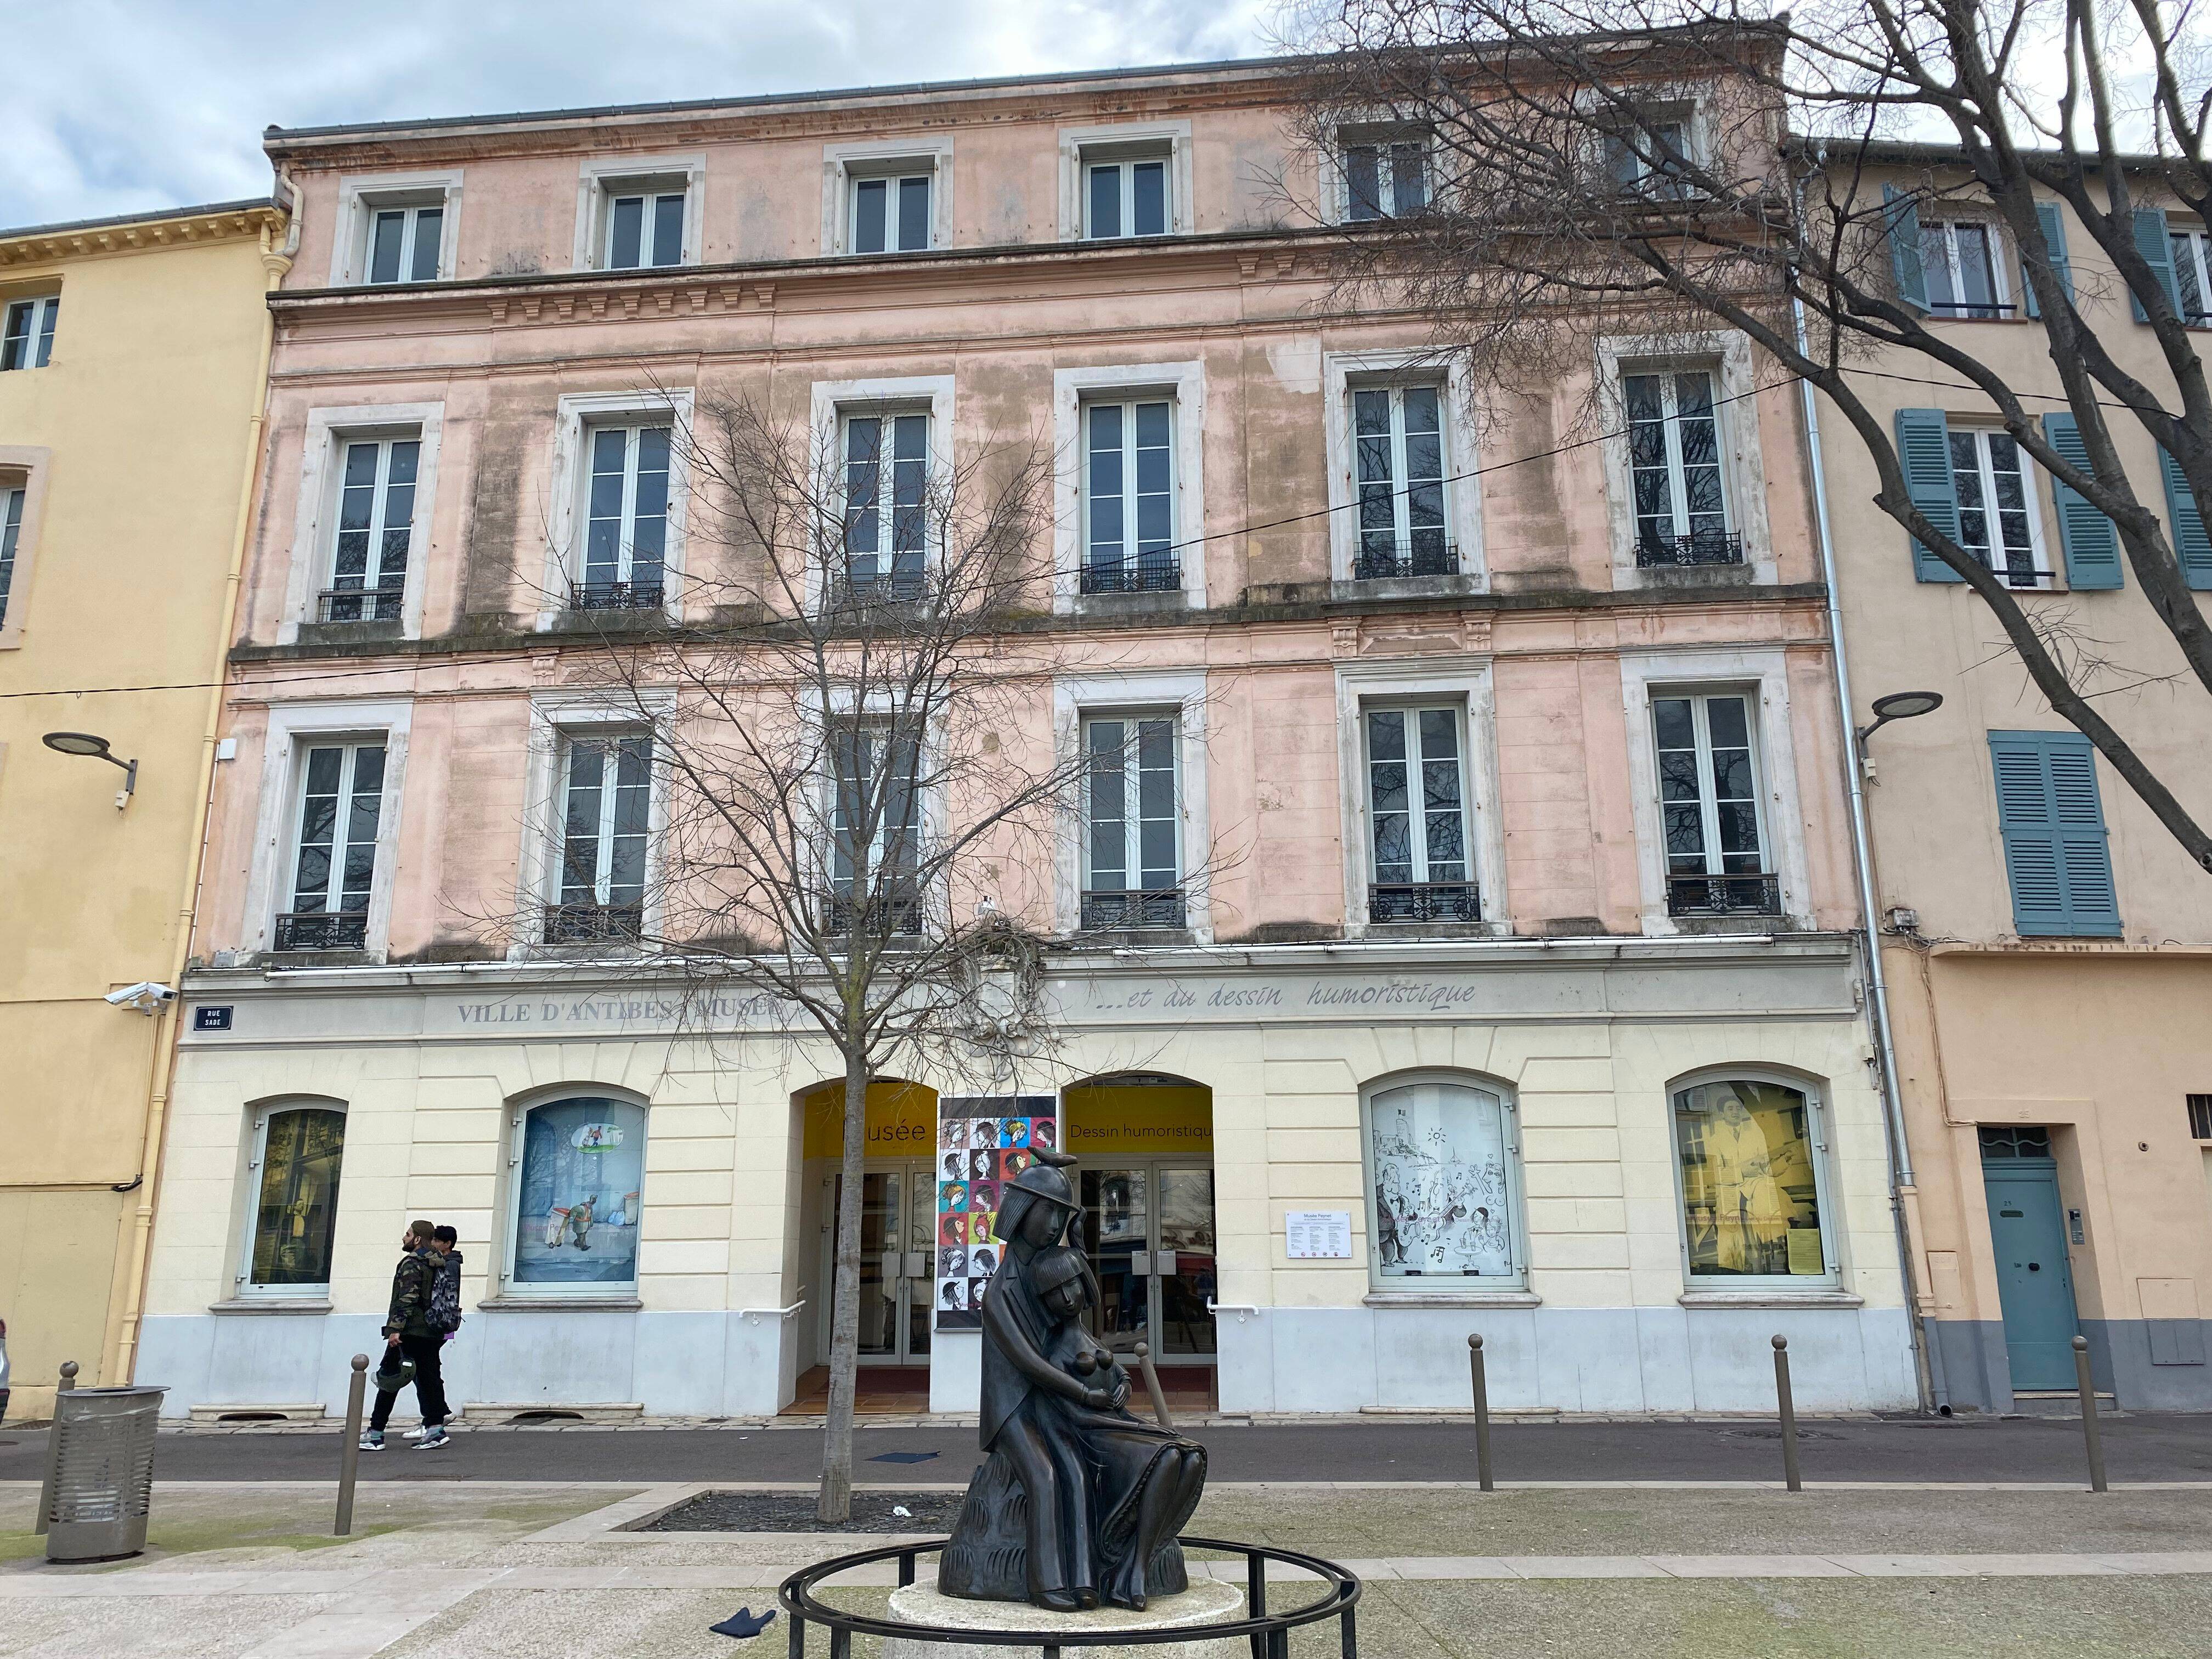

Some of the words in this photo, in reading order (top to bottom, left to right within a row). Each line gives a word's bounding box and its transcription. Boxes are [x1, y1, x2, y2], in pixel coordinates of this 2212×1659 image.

[1163, 986, 1197, 1008] du
[1207, 982, 1285, 1007] dessin
[1306, 981, 1476, 1011] humoristique
[457, 1003, 531, 1023] VILLE
[541, 1000, 673, 1022] D'ANTIBES
[843, 1119, 926, 1142] usée
[1070, 1124, 1119, 1138] Dessin
